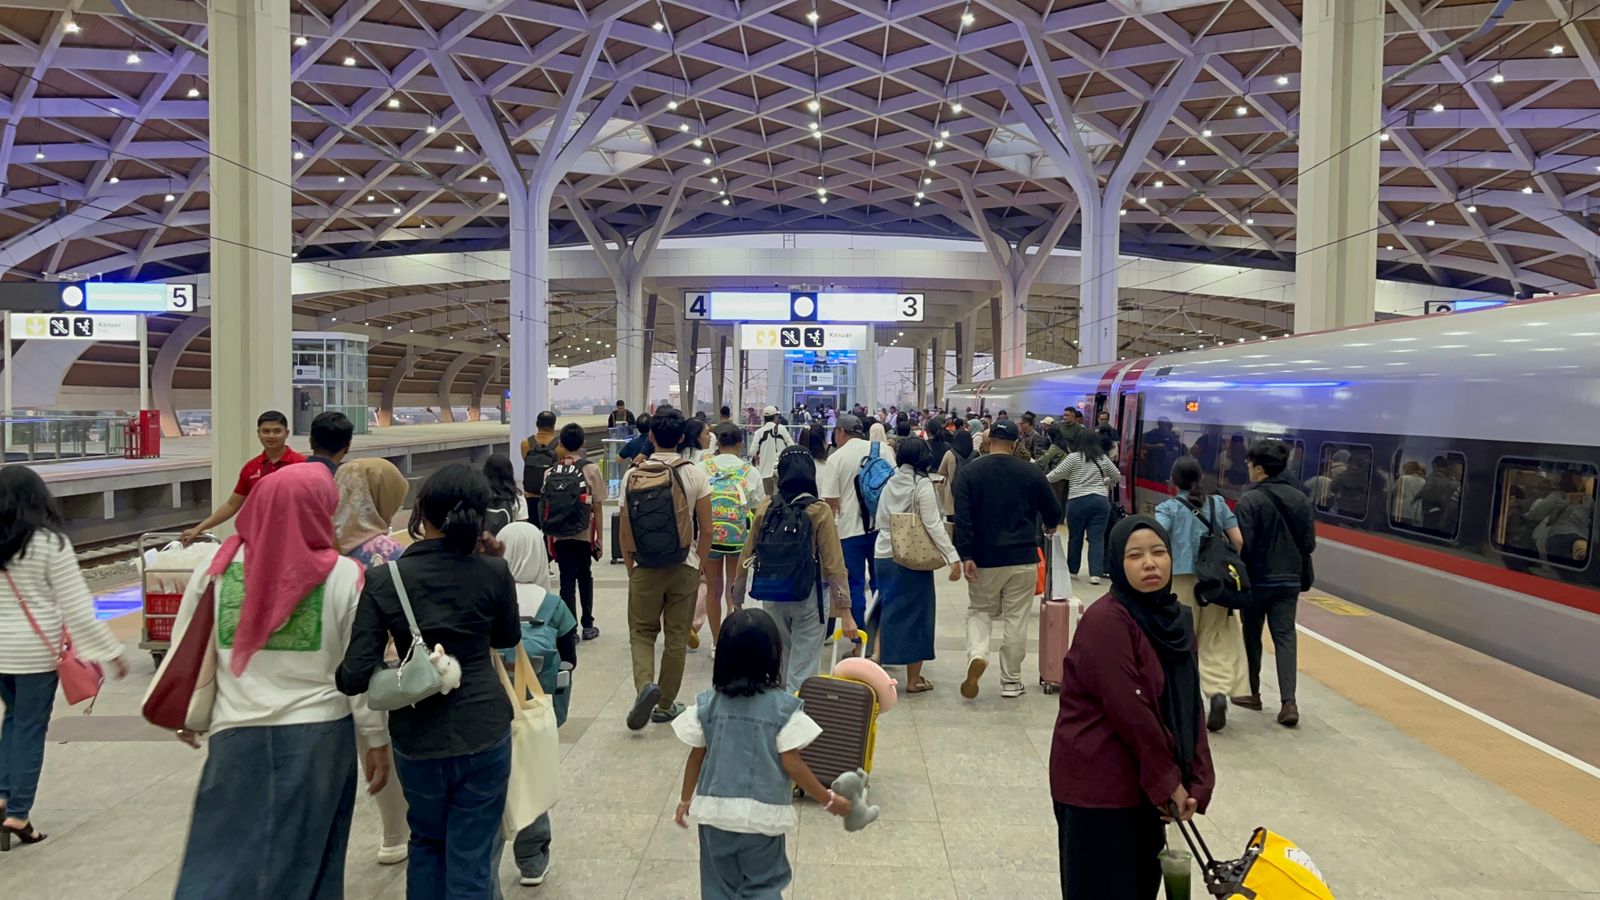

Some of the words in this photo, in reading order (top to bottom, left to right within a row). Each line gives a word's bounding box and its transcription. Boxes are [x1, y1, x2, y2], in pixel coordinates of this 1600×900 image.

[173, 287, 187, 308] 5
[689, 295, 707, 316] 4
[902, 296, 918, 317] 3
